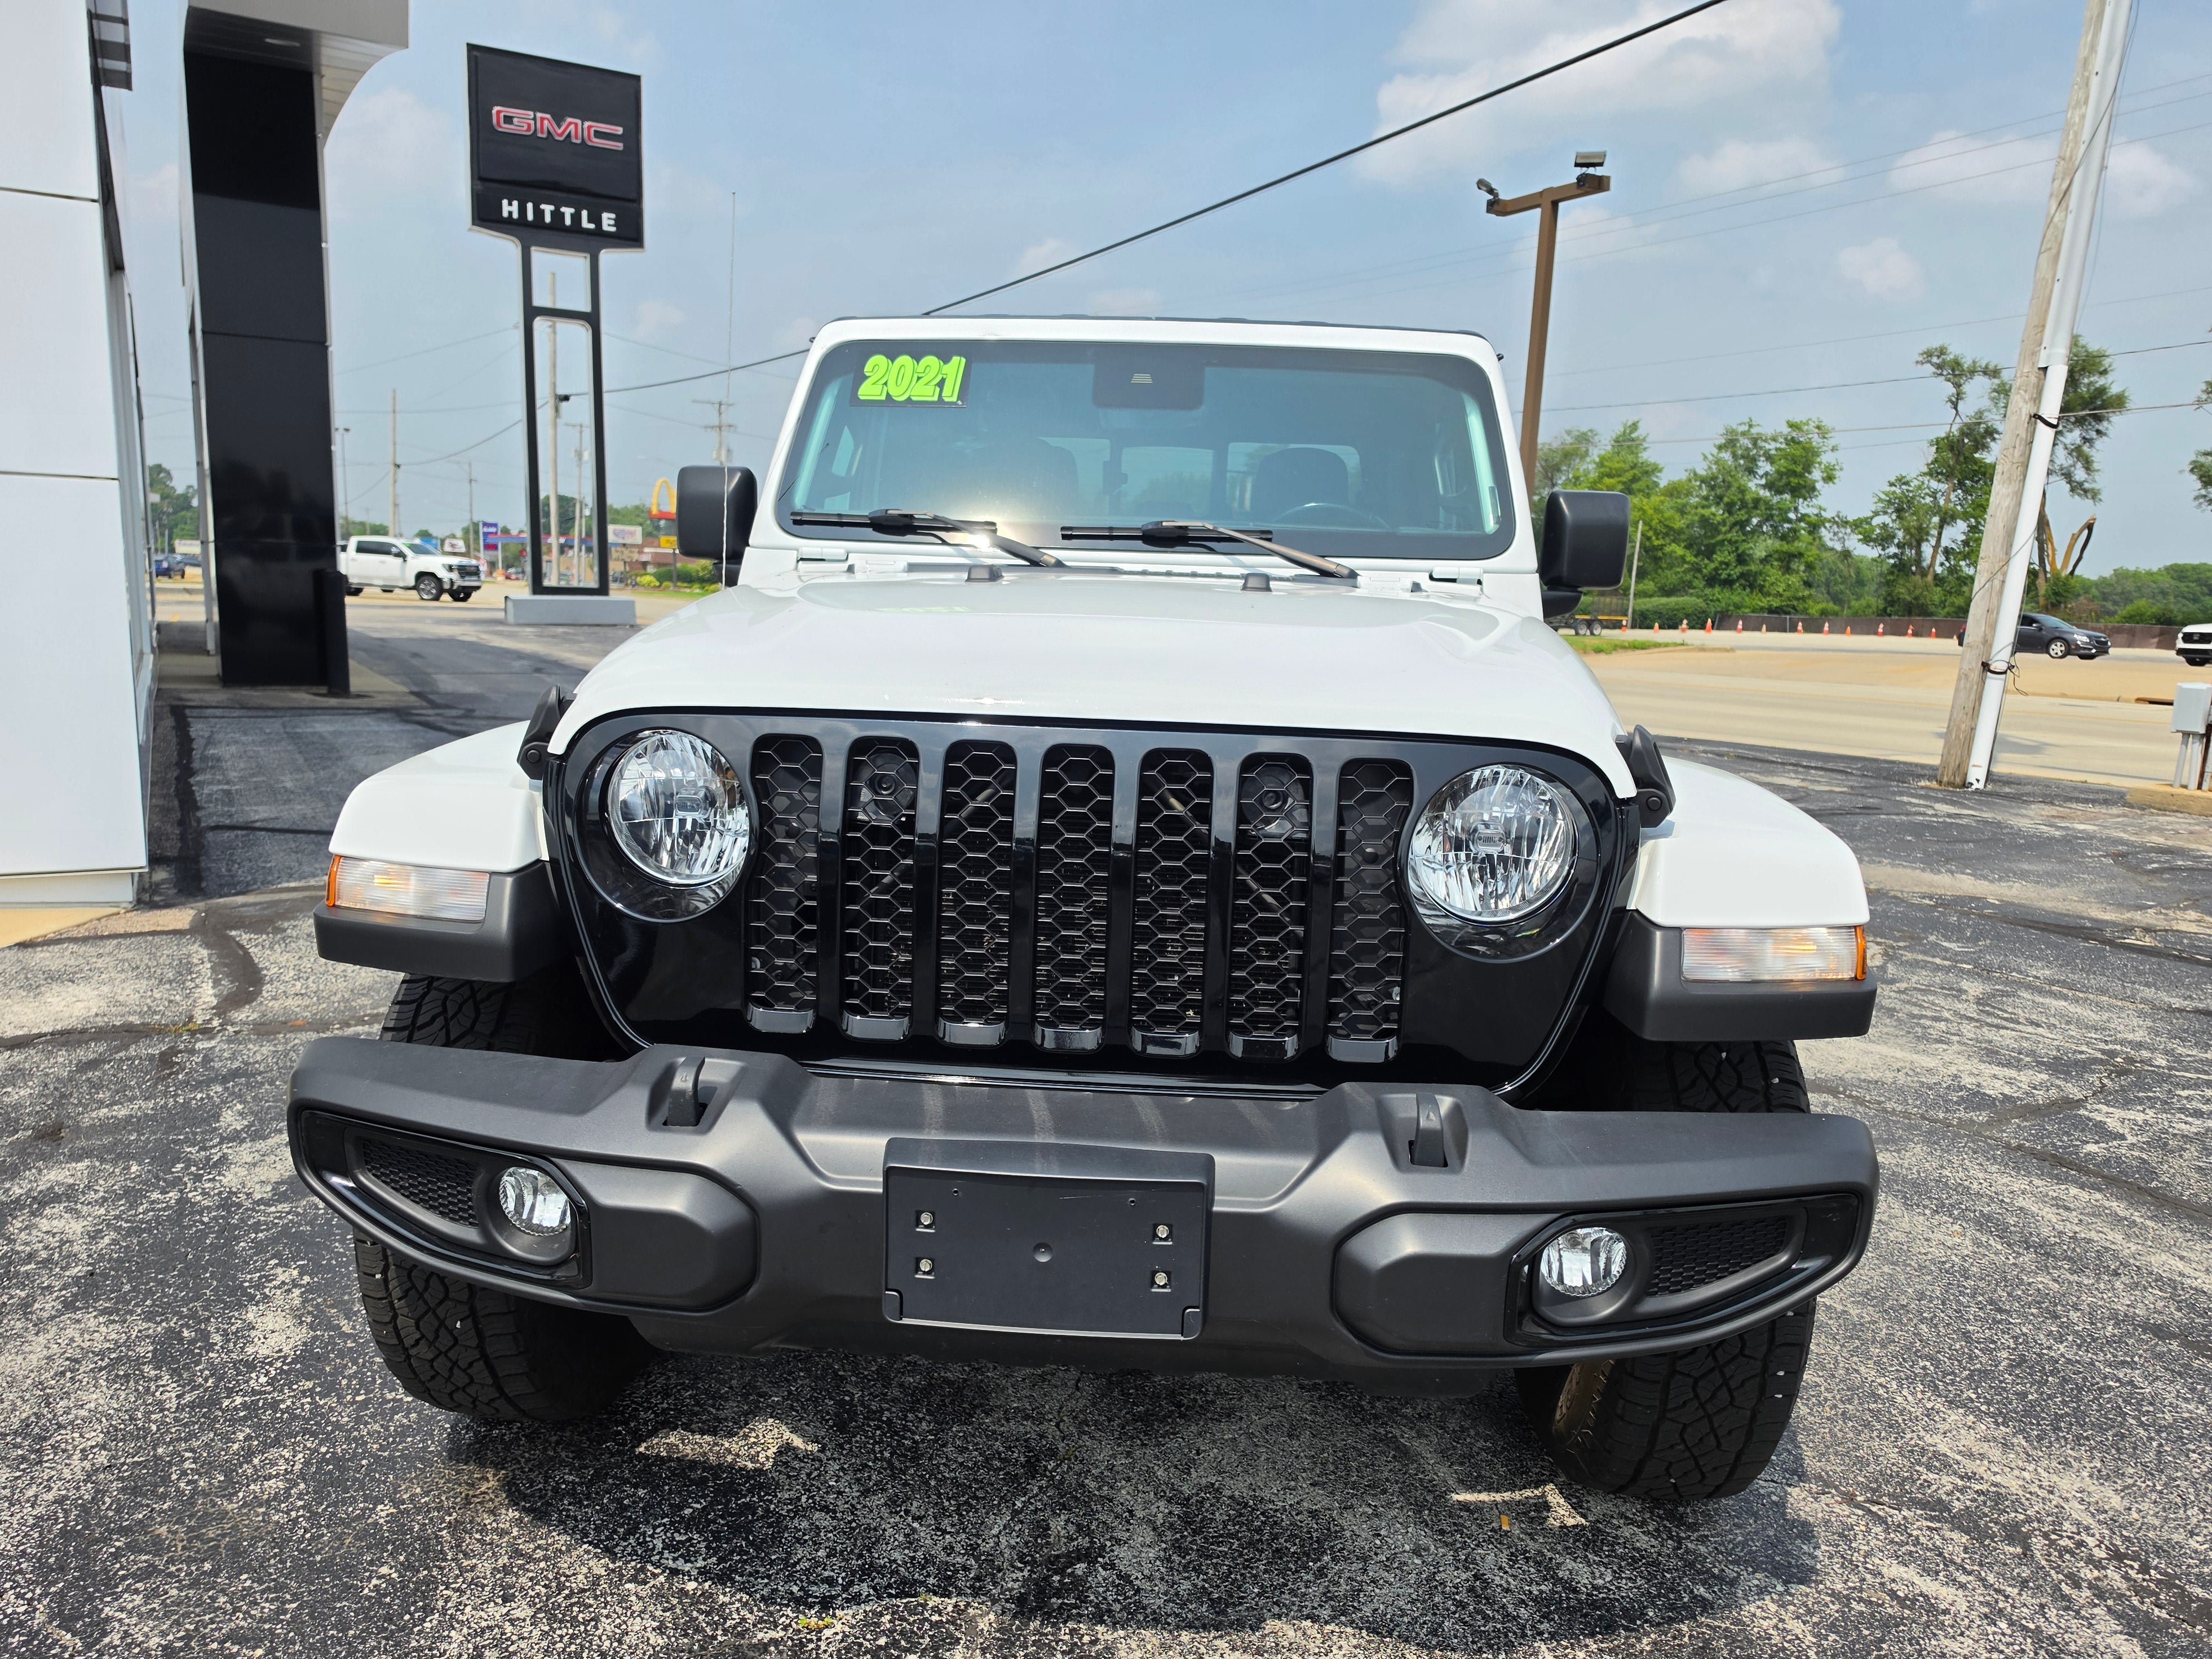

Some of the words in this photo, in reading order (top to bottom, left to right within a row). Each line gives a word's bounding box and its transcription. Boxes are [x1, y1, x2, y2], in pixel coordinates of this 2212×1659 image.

[492, 106, 624, 150] GMC
[502, 199, 617, 232] HITTLE
[857, 354, 966, 402] 2021
